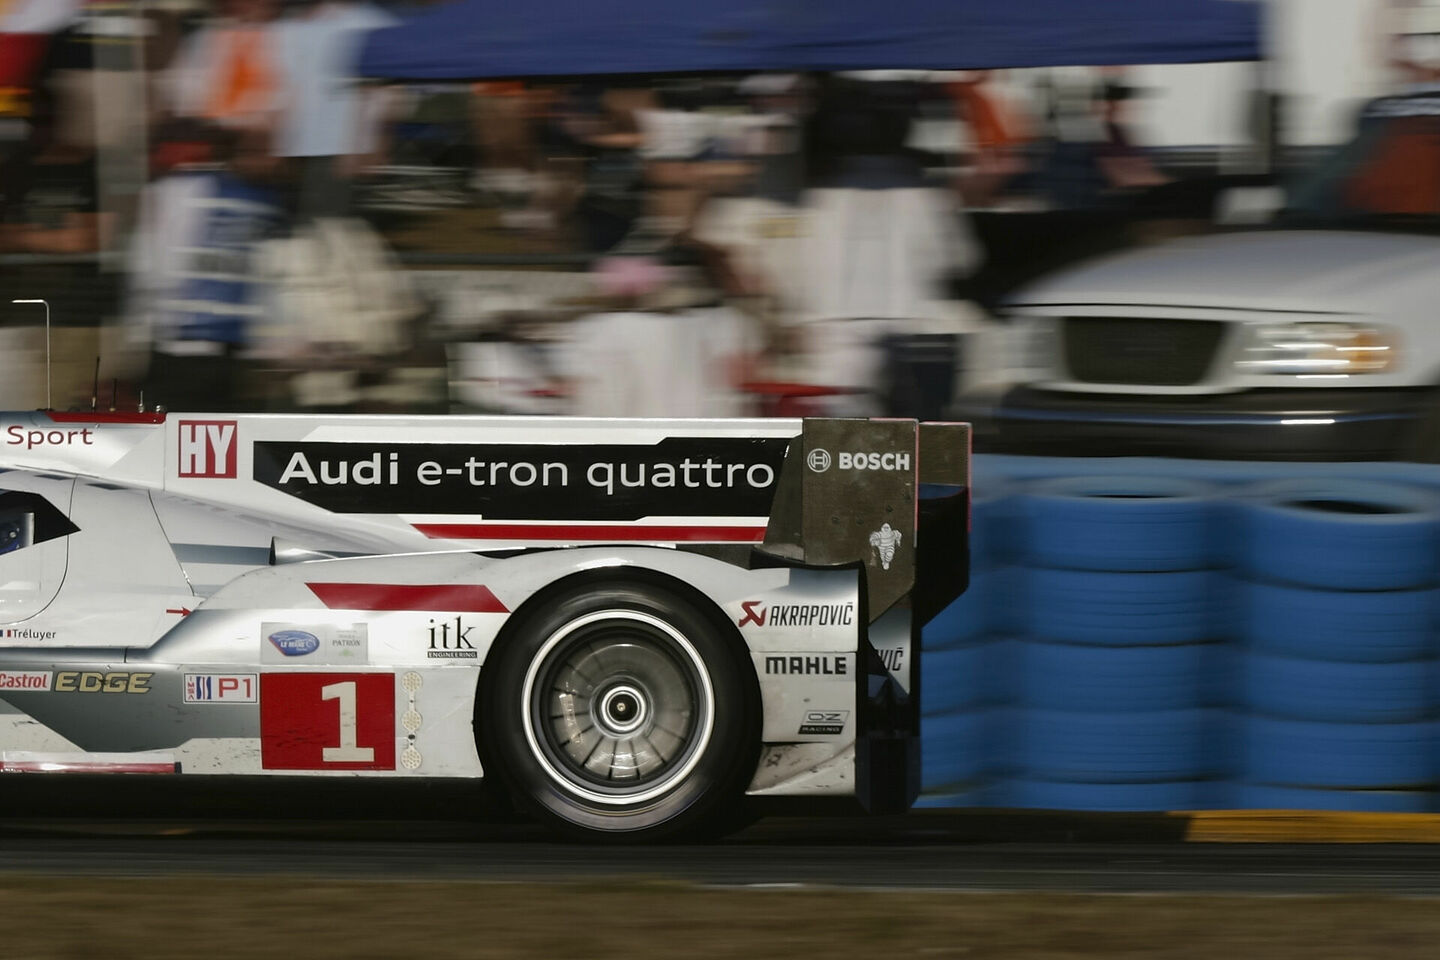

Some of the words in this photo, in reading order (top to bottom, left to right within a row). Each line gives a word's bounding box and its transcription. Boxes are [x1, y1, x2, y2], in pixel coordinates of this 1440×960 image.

[6, 426, 94, 450] Sport
[180, 425, 235, 474] HY
[839, 452, 910, 471] BOSCH
[279, 452, 399, 486] Audi
[416, 455, 568, 486] e-tron
[586, 455, 775, 495] quattro
[12, 628, 57, 641] Tréluyer
[427, 615, 478, 649] itk
[765, 657, 847, 675] MAHLE
[55, 671, 155, 693] EDGE
[218, 677, 251, 698] P1
[322, 681, 375, 762] 1
